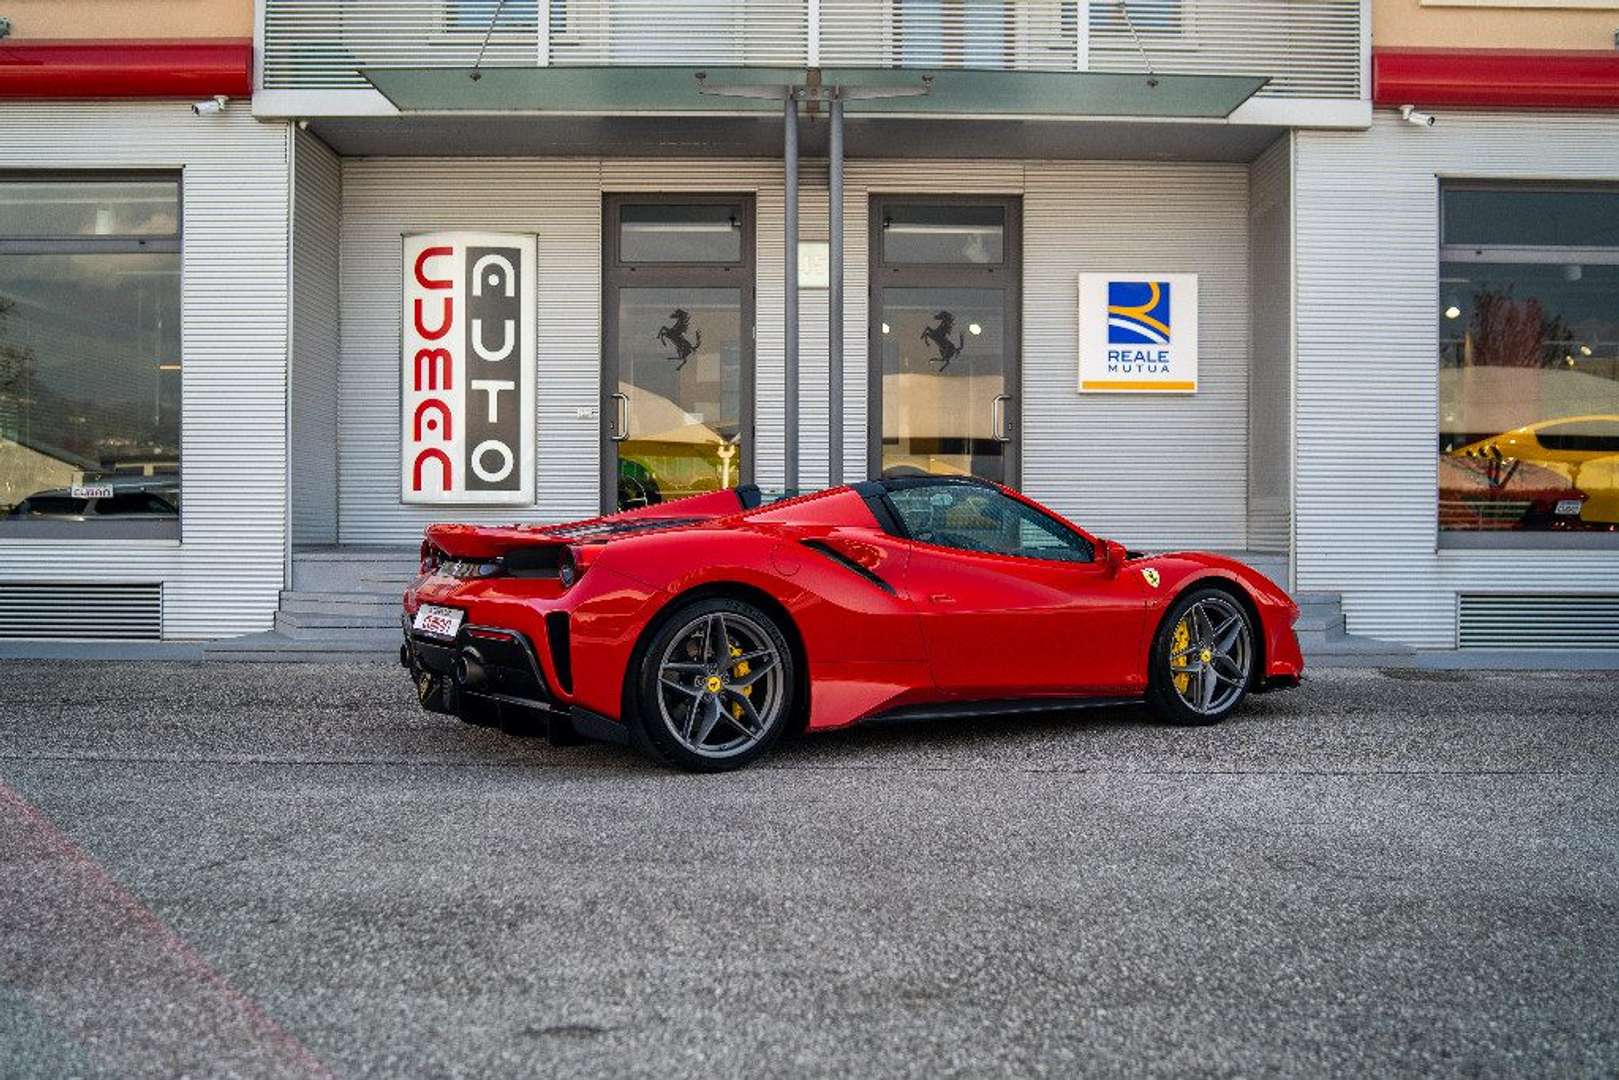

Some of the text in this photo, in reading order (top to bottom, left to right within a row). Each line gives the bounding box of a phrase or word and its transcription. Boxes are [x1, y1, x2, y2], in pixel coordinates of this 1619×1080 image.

[413, 247, 453, 491] CUMAN
[471, 254, 515, 483] AUTO
[1108, 350, 1170, 363] REALE
[1108, 365, 1170, 373] MUTUA
